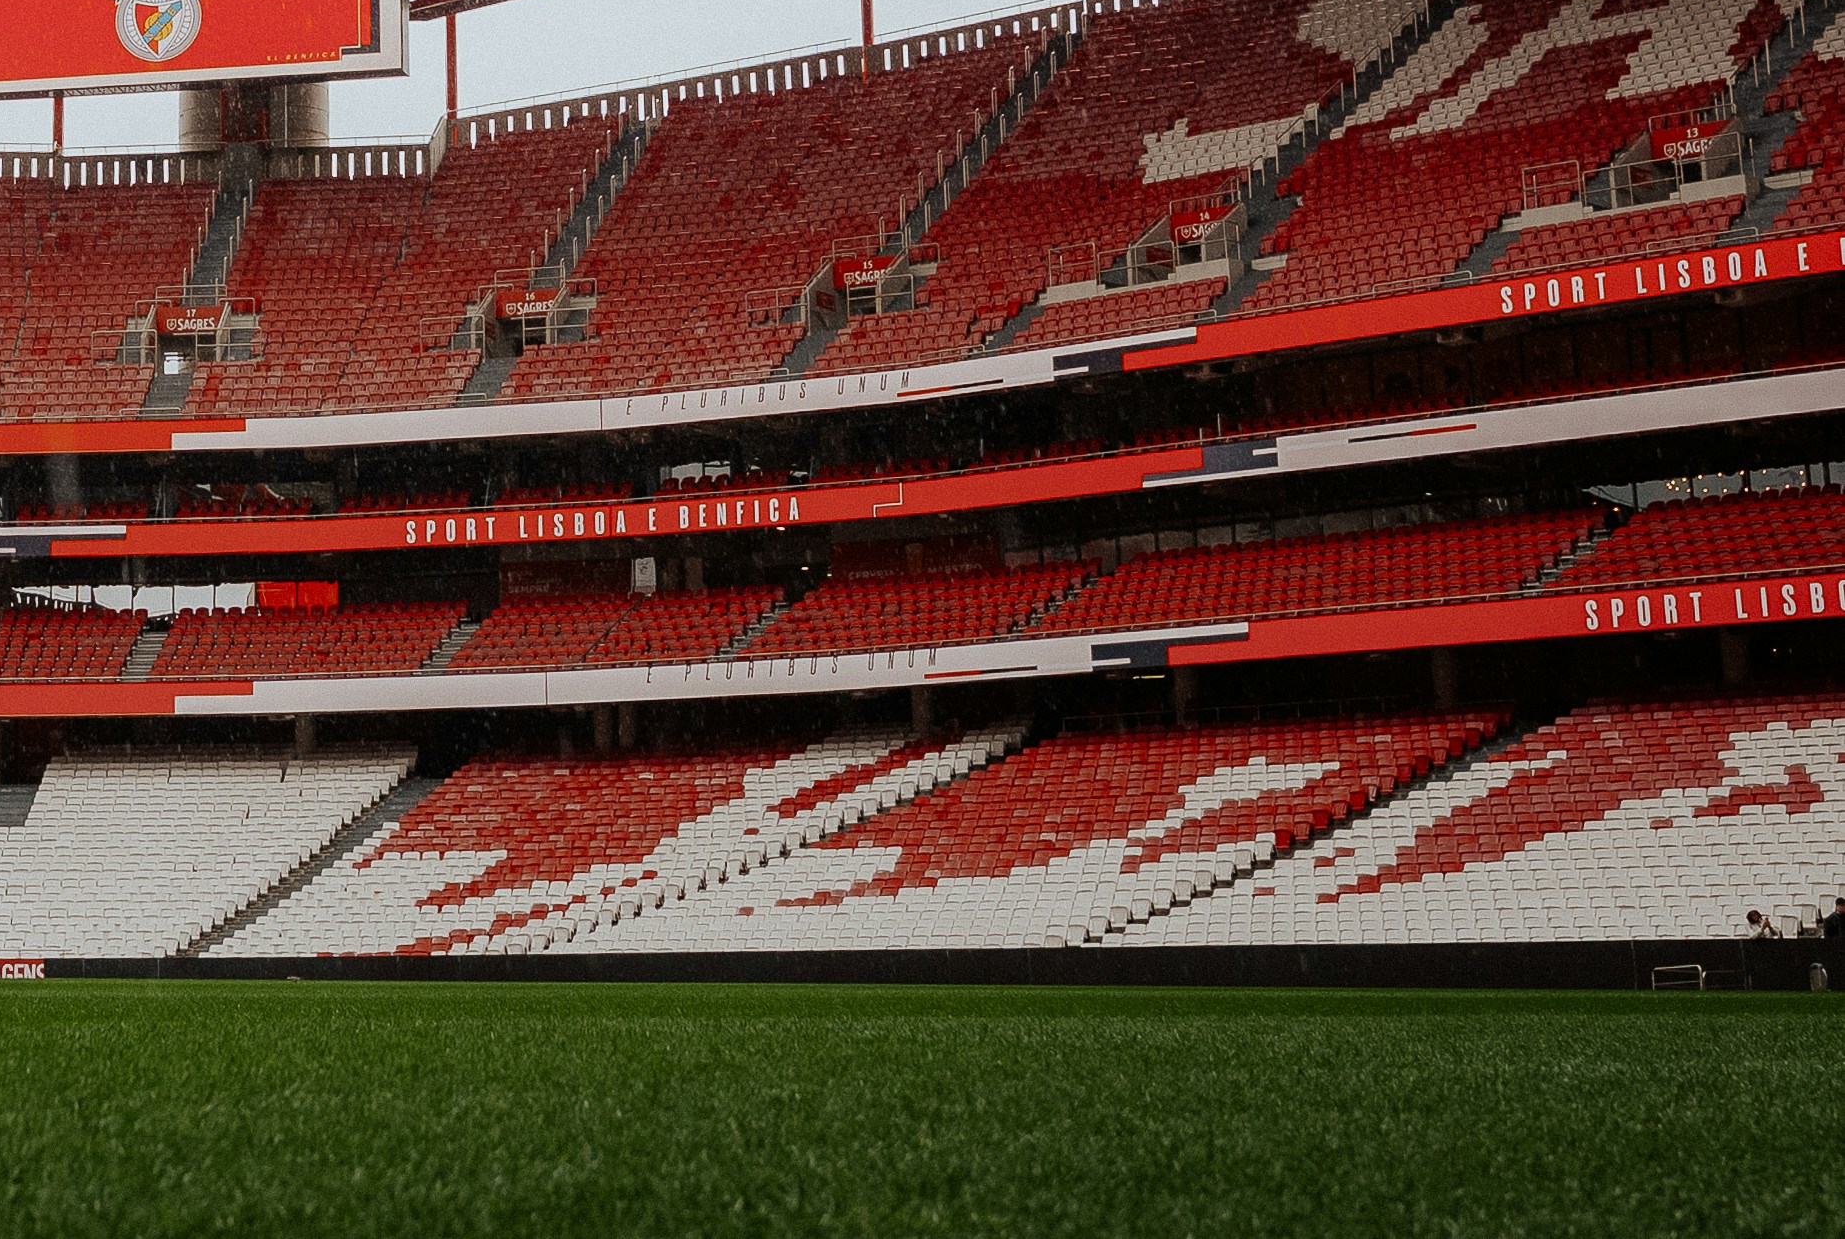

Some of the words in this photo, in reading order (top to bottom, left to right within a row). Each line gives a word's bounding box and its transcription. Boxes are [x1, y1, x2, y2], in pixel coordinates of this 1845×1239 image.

[286, 52, 335, 60] BENFICA
[1686, 127, 1699, 139] 13
[1199, 211, 1211, 221] 14
[862, 260, 873, 269] 15
[1500, 272, 1606, 313] SPORT
[1635, 248, 1768, 294] LISBOA
[1797, 243, 1810, 271] E
[525, 292, 535, 301] 16
[186, 309, 197, 317] 17
[177, 317, 215, 331] SAGRES
[626, 399, 633, 415] E
[661, 382, 806, 411] PLURIBUS
[837, 372, 911, 395] UNUM
[405, 517, 496, 544] SPORT
[519, 510, 627, 539] LISBOA
[648, 508, 657, 531] E
[679, 496, 801, 529] BENFICA
[1585, 591, 1702, 630] SPORT
[684, 655, 838, 682] PLURIBUS
[868, 648, 936, 671] UNUM
